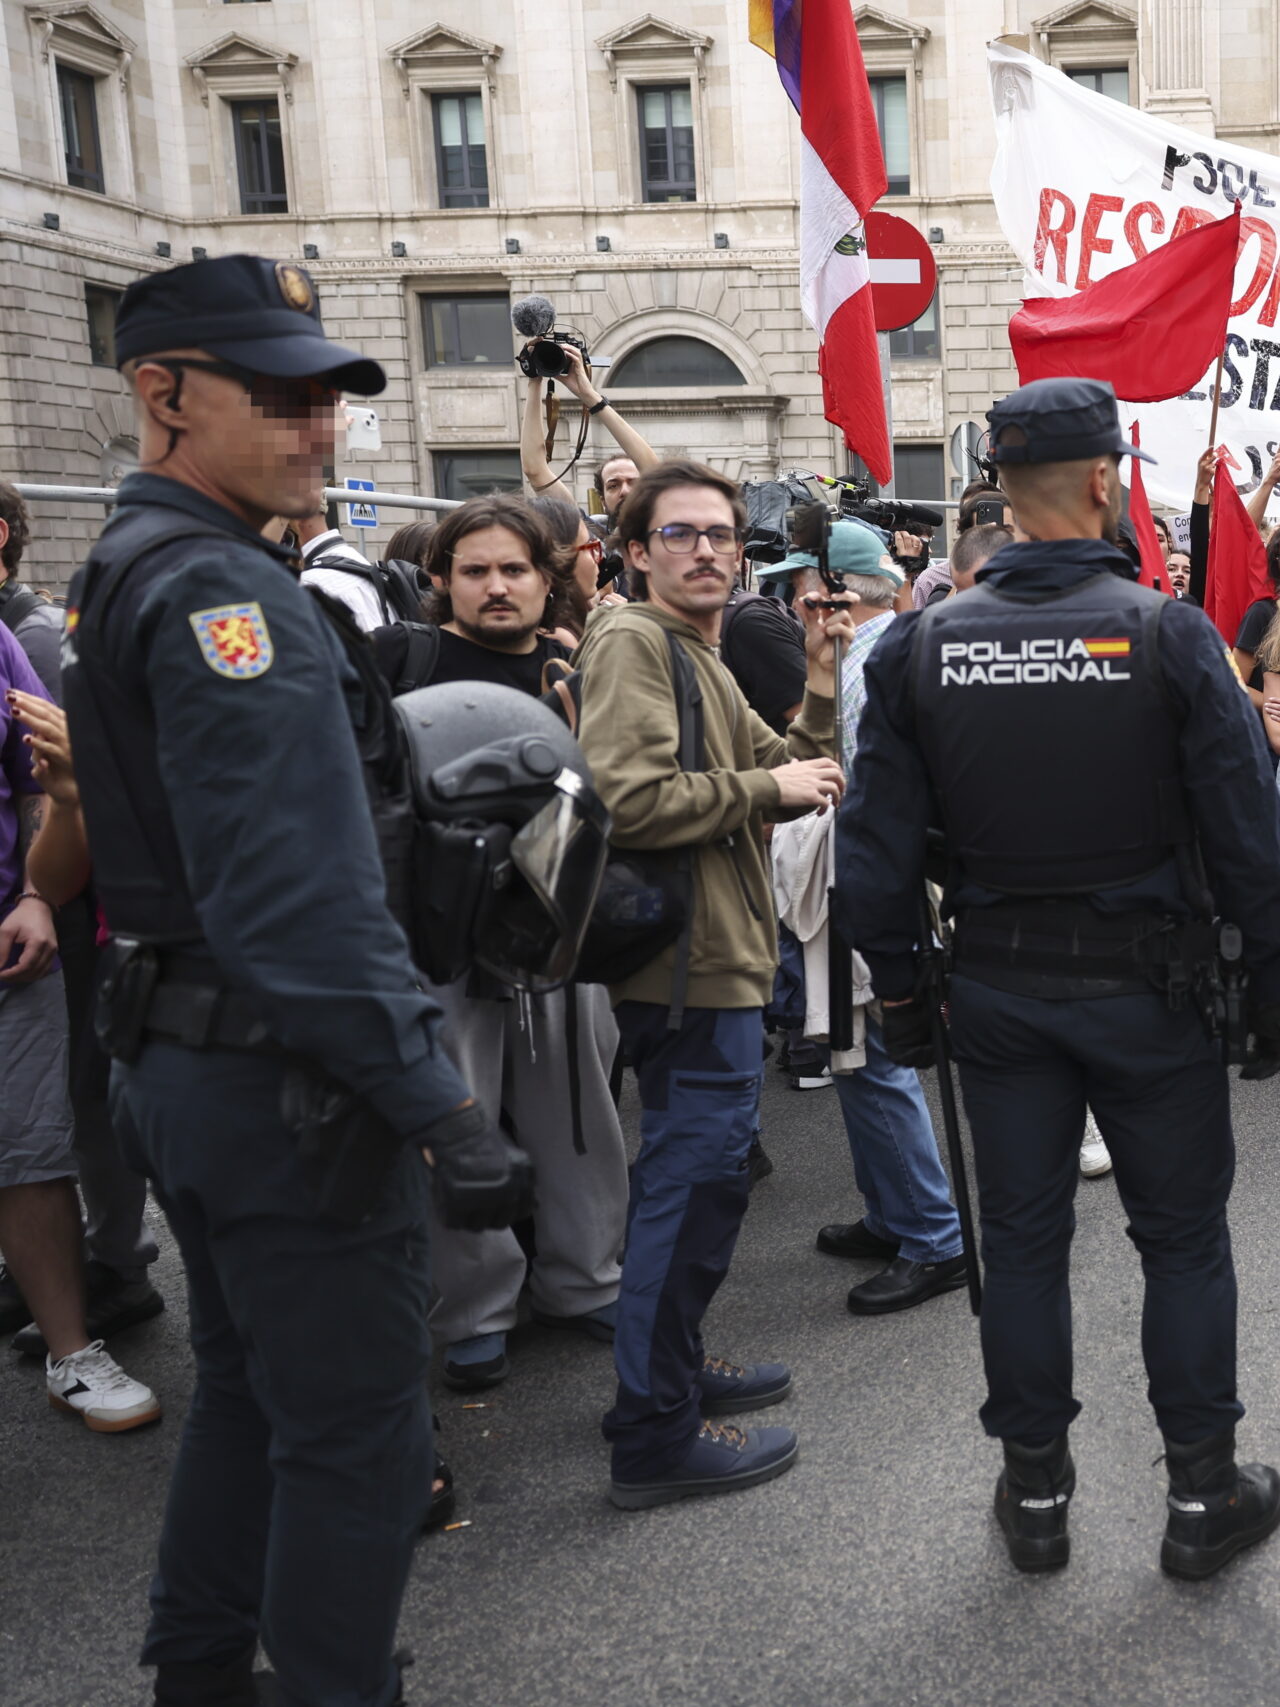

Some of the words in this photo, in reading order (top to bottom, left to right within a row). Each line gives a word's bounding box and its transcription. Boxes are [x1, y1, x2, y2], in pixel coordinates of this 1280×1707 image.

[1161, 144, 1276, 208] PSOE
[941, 638, 1091, 664] POLICIA
[941, 660, 1131, 686] NACIONAL
